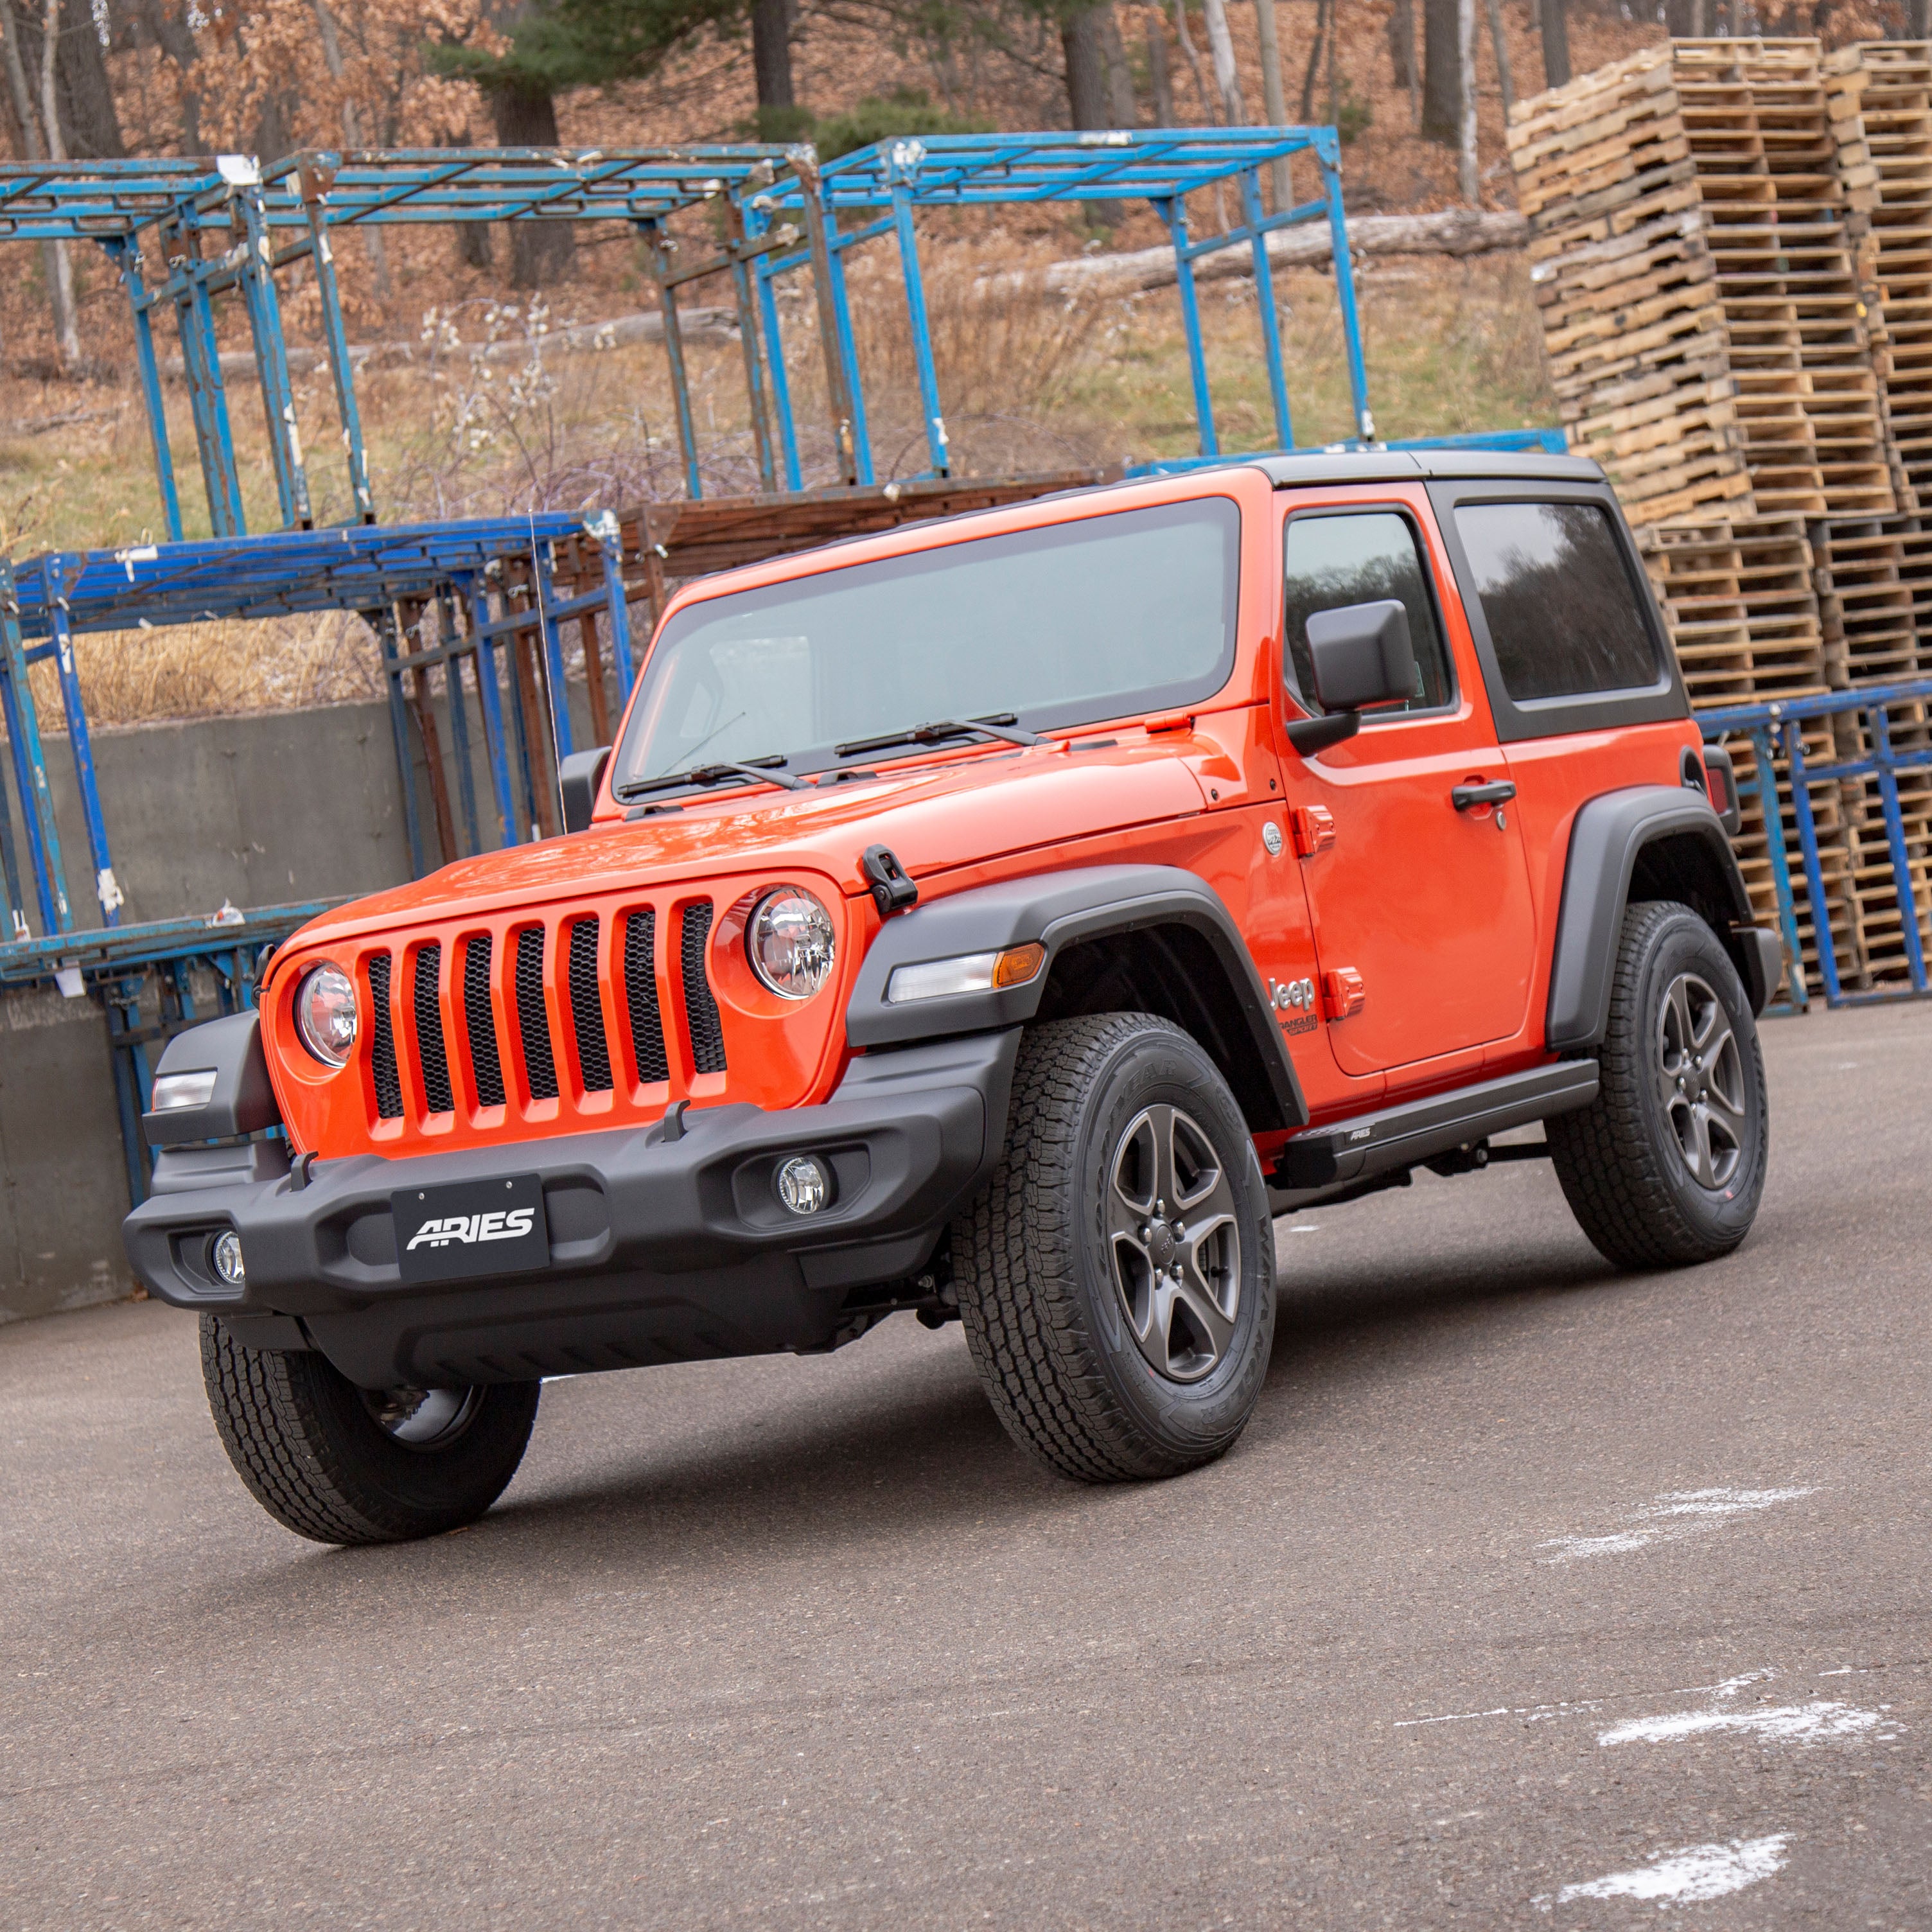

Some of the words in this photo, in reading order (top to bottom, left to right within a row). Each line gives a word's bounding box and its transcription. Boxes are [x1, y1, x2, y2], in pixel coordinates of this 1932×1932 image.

[1269, 978, 1315, 1012] Jeep
[1279, 1014, 1318, 1029] RANGLER
[1350, 1127, 1371, 1141] ARIES
[406, 1208, 535, 1251] ARIES
